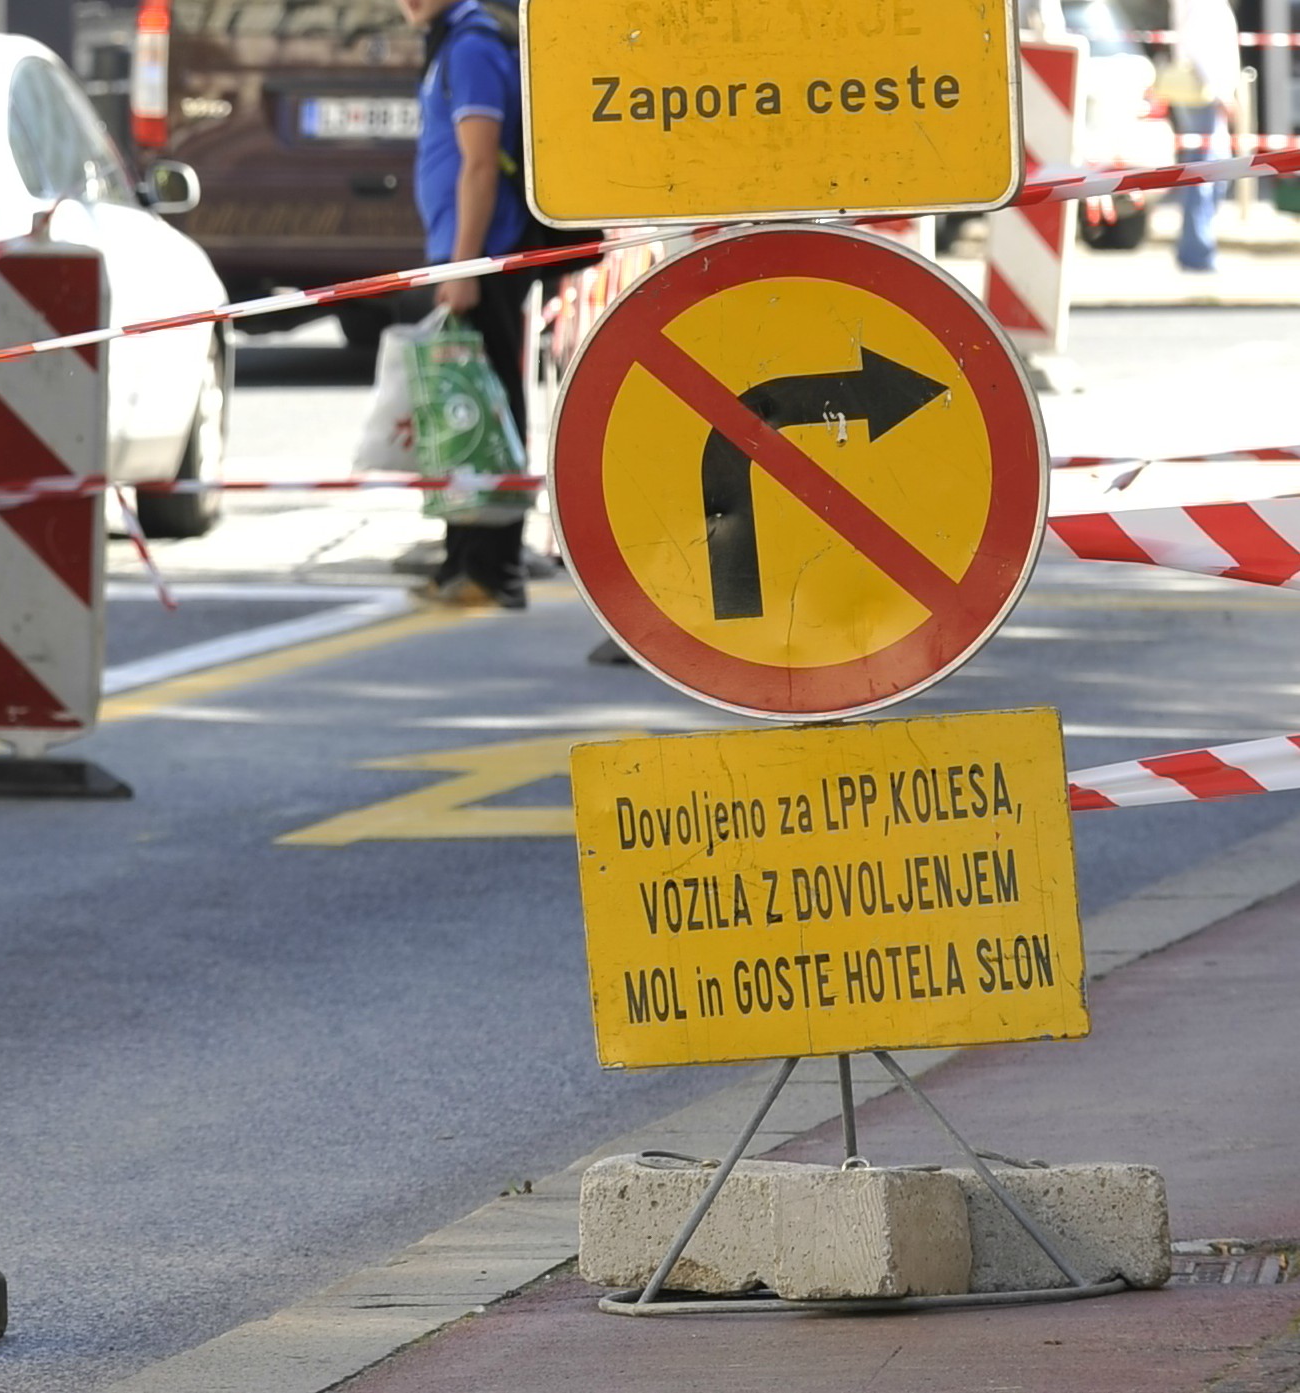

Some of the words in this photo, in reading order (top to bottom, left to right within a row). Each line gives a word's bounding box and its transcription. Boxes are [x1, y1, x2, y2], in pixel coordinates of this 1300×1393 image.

[591, 76, 782, 132] Zapora
[806, 64, 961, 115] ceste
[616, 790, 766, 858] Dovoljeno
[779, 791, 813, 835] za
[639, 873, 753, 935] VOZILA
[761, 871, 783, 925] Z
[791, 848, 1021, 923] DOVOLJENJEM
[624, 966, 688, 1025] MOL
[697, 967, 724, 1018] in
[733, 953, 837, 1016] GOSTE
[843, 941, 966, 1005] HOTELA
[976, 933, 1055, 995] SLON
